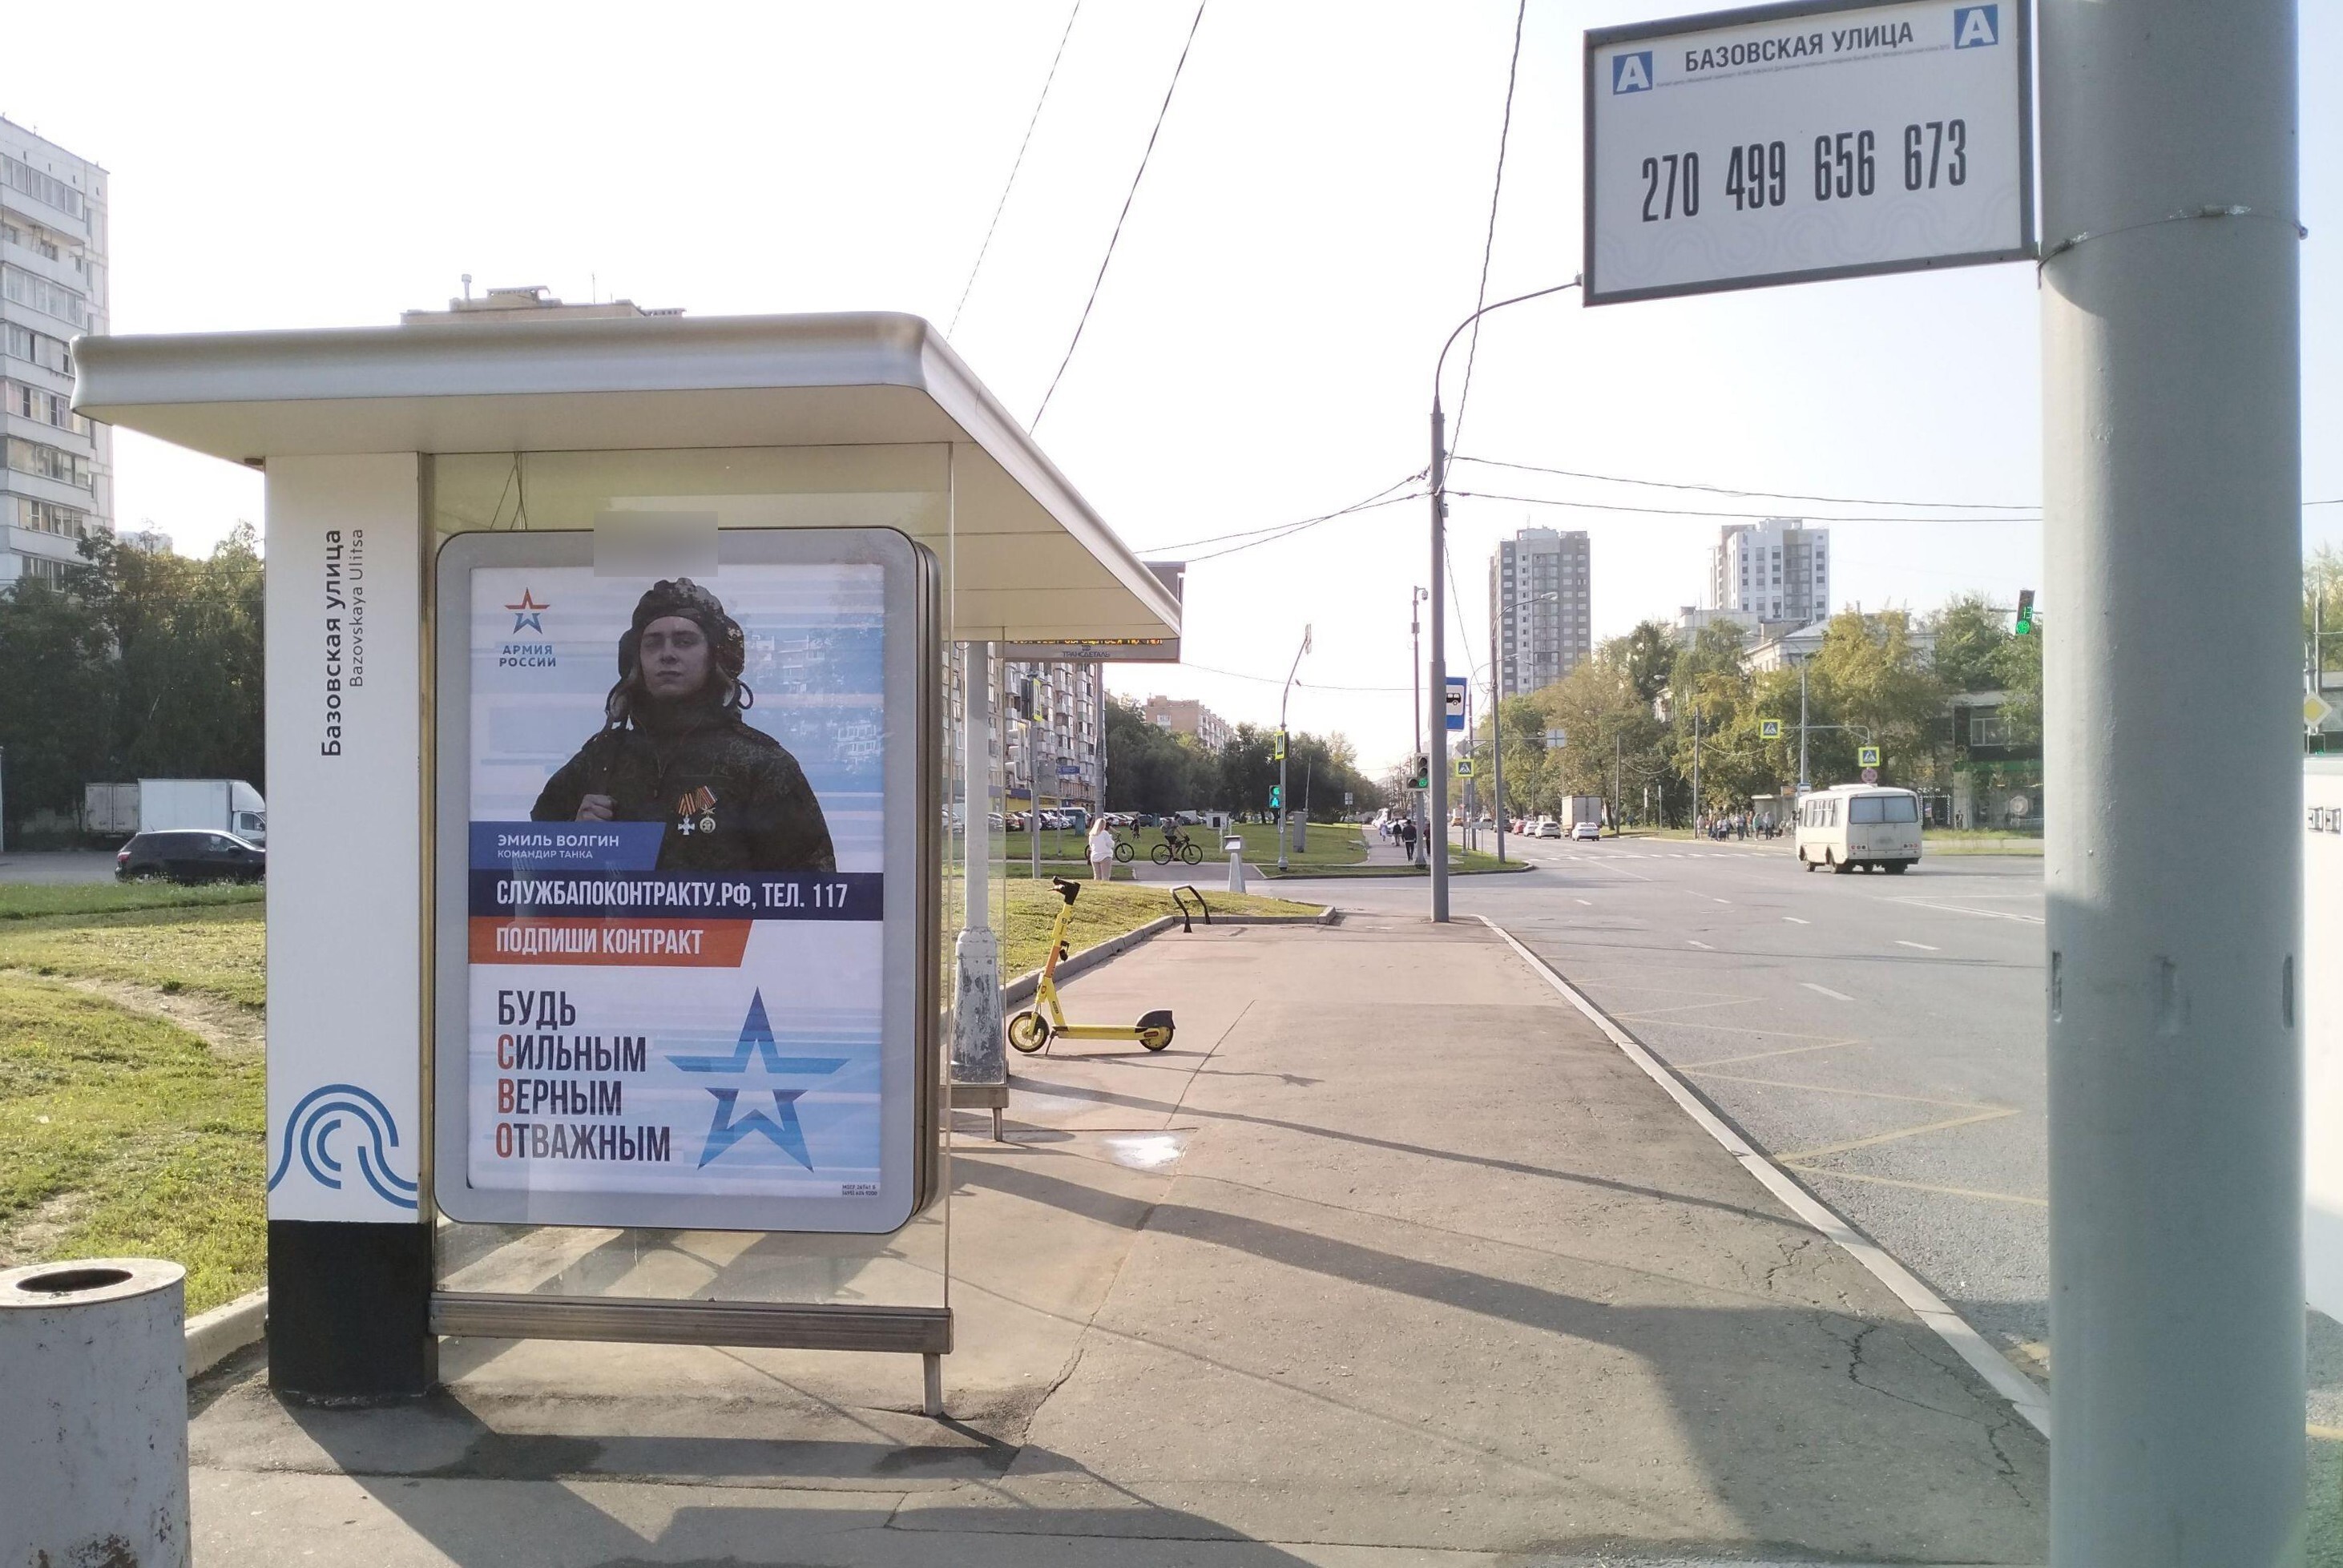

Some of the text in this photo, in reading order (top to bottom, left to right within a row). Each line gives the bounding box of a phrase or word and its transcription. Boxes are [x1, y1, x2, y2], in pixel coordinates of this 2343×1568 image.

[1685, 32, 1823, 72] БАЗОВСКАЯ
[1831, 21, 1914, 52] УЛИЦА
[1641, 118, 1967, 223] 270 499 656 673
[349, 529, 366, 687] Bazovskaya Ulitsa
[321, 530, 345, 757] Базовская улица
[499, 656, 556, 667] РОССИИ
[502, 644, 553, 655] АРМИЯ
[1062, 651, 1111, 659] ТРАНСДЕТАЛЬ
[497, 834, 619, 847] ЭМИЛЬ ВОЛГИН
[497, 849, 593, 860] КОМАНДИР ТАНКА
[496, 879, 848, 911] СЛУЖБАПОКОНТРАКТУ.РФ, ТЕЛ. 117
[496, 926, 704, 956] ПОДПИШИ КОНТРАКТ
[498, 990, 577, 1031] БУДЬ
[497, 1034, 647, 1072] СИЛЬНЫМ
[498, 1078, 623, 1116] ВЕРНЫМ
[495, 1123, 671, 1162] ОТВАЖНЫМ
